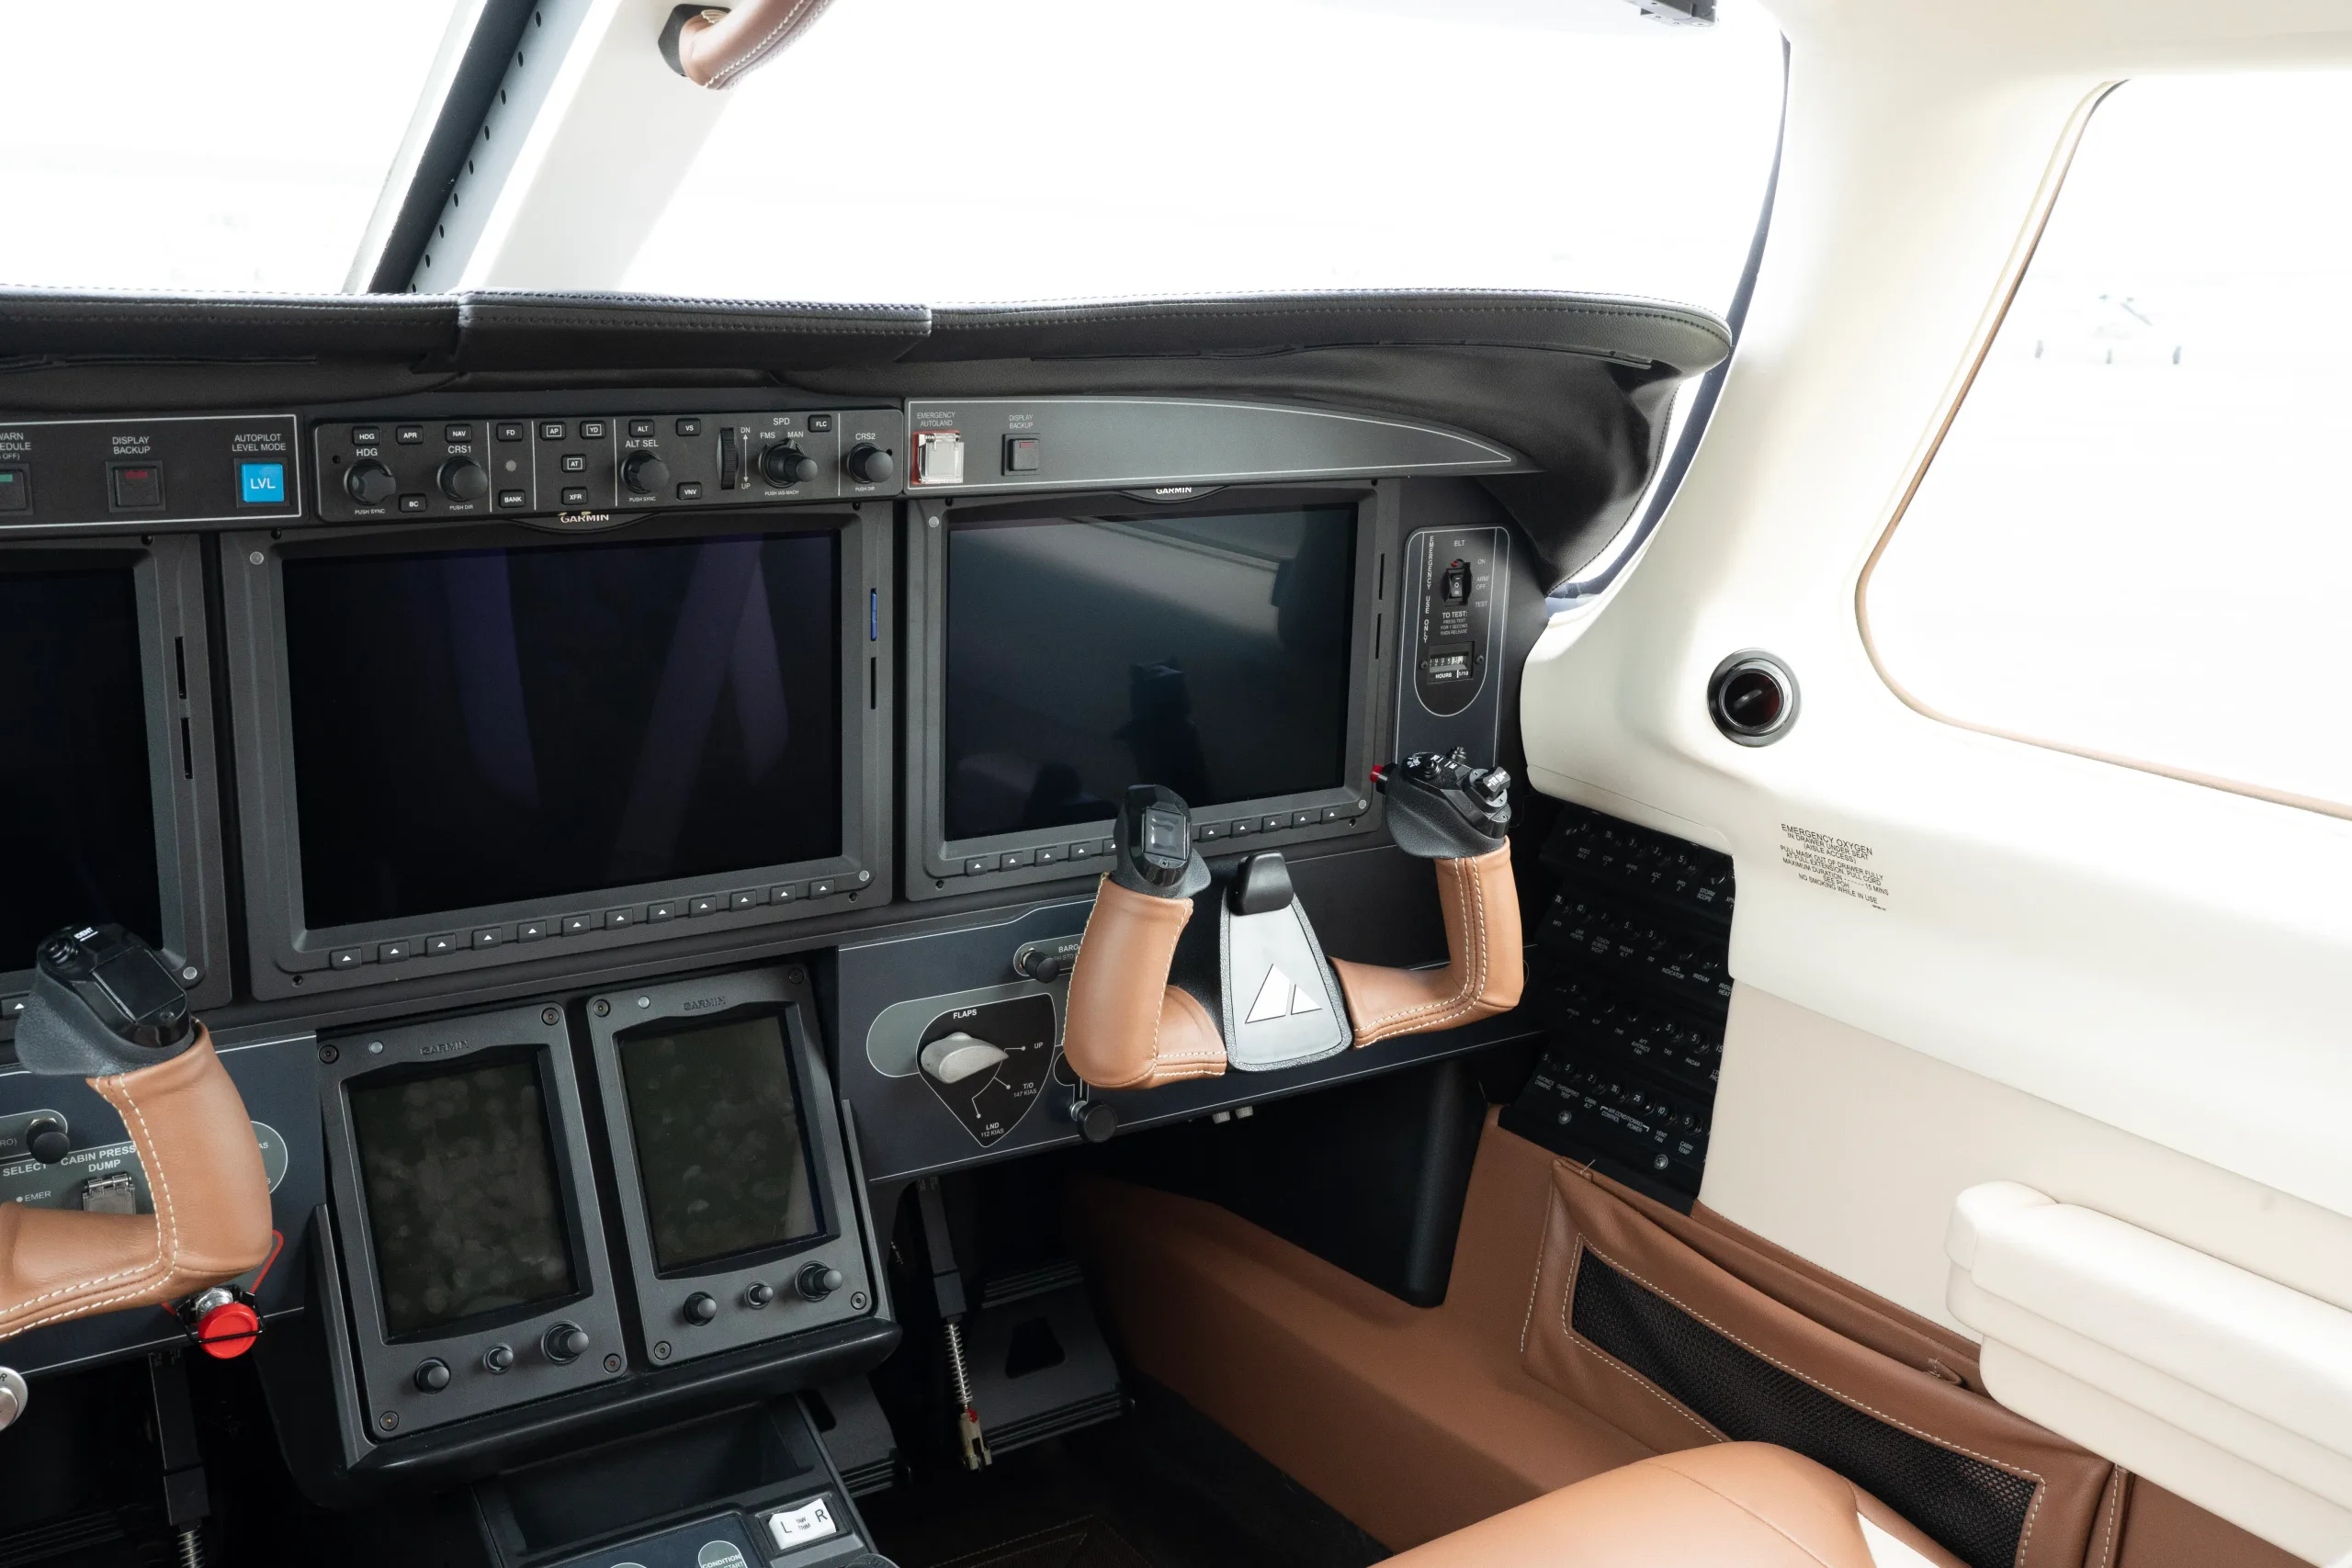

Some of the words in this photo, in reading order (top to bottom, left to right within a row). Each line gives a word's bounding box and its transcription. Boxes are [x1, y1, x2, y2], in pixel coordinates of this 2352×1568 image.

[773, 418, 789, 426] SPD
[112, 436, 150, 446] DISPLAY
[234, 434, 281, 443] AUTOPILOT
[625, 440, 639, 448] ALT
[642, 439, 658, 447] SEL
[113, 446, 151, 455] BACKUP
[232, 443, 258, 452] LEVEL
[261, 443, 287, 452] MODE
[356, 448, 378, 457] HDG
[448, 446, 471, 454] CRS1
[250, 477, 276, 490] LVL
[560, 514, 609, 524] GARMIN
[1453, 539, 1465, 547] ELT
[1452, 610, 1468, 618] TEST:
[1781, 823, 1834, 844] EMERGENCY
[1837, 838, 1872, 856] OXYGEN
[1796, 834, 1824, 847] DRAWER
[1826, 843, 1849, 854] UNDER
[1852, 850, 1868, 861] SEAT
[1826, 848, 1856, 864] ACCESS)
[1781, 844, 1794, 855] PULL
[1796, 849, 1812, 859] MASK
[1865, 870, 1883, 881] FULLY
[1782, 857, 1811, 872] MAXIMUM
[1813, 866, 1842, 881] DURATION
[1865, 883, 1871, 891] 15
[1872, 885, 1888, 896] MINS
[1823, 874, 1835, 883] SEE
[1799, 873, 1807, 881] NO
[1809, 876, 1836, 891] SMOKING
[1838, 885, 1856, 897] WHILE
[1865, 895, 1878, 905] USE
[1058, 943, 1079, 953] BARO
[684, 996, 726, 1011] GARMIN
[953, 1009, 977, 1020] FLAPS
[420, 1040, 469, 1055] GARMIN
[1013, 1090, 1023, 1099] 147
[1023, 1088, 1036, 1096] KIAS
[986, 1122, 1000, 1131] LND
[980, 1130, 989, 1138] 112
[990, 1128, 1004, 1136] KIAS
[61, 1152, 96, 1166] CABIN
[98, 1145, 136, 1159] PRESS
[88, 1158, 121, 1173] DUMP
[24, 1190, 51, 1202] EMER
[814, 1508, 827, 1523] R
[780, 1521, 792, 1534] L
[797, 1522, 811, 1531] TRIM
[702, 1553, 741, 1568] CONDITION
